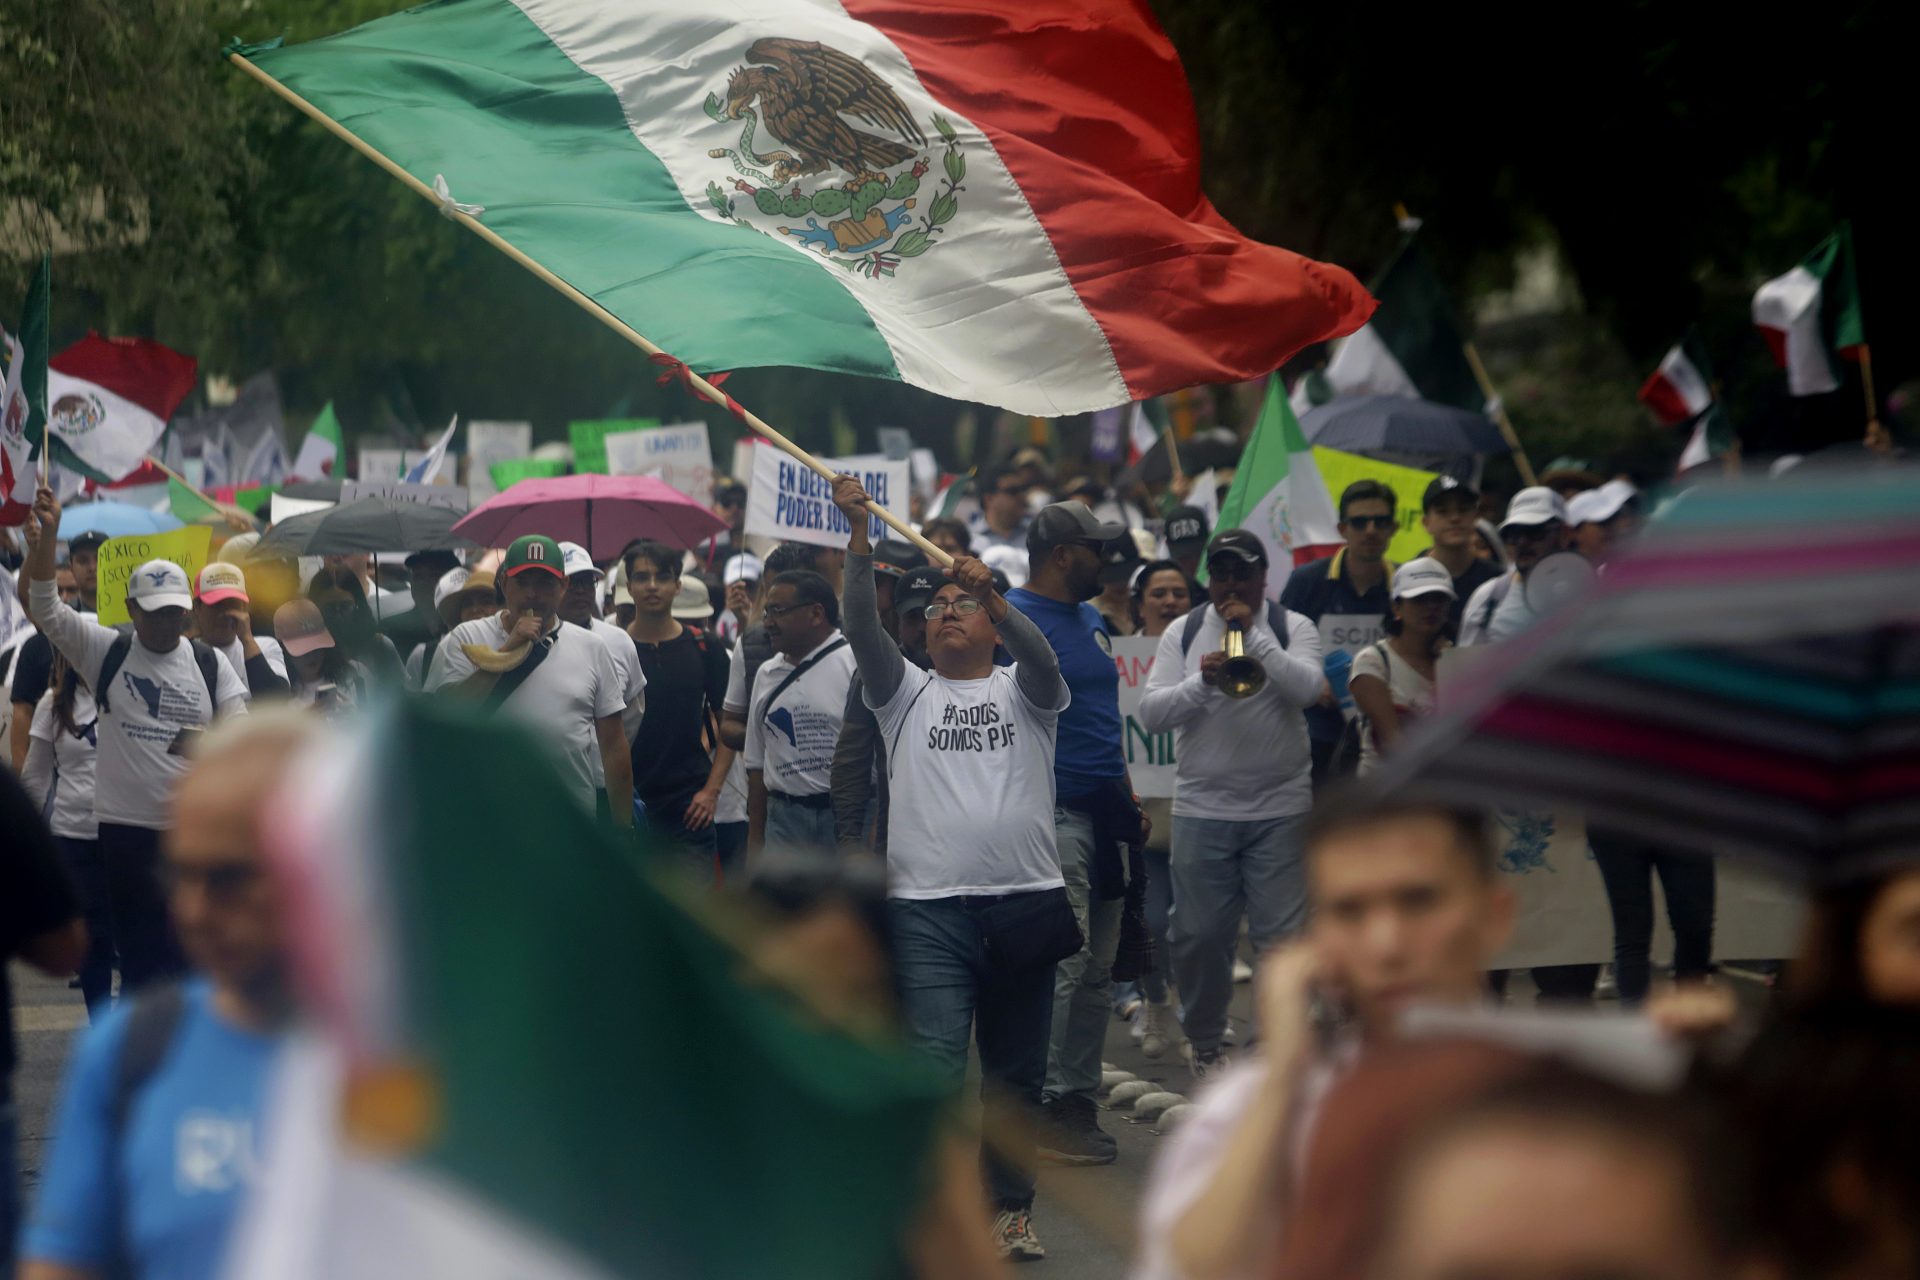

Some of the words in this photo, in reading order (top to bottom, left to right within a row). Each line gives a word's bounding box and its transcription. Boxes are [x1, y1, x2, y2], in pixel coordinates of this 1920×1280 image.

[779, 461, 796, 492] EN
[799, 466, 862, 500] DEFE
[865, 472, 889, 505] DEL
[776, 493, 823, 530] PODER
[826, 504, 889, 539] JUDIAL
[928, 726, 983, 752] SOMOS
[987, 723, 1016, 751] PJF
